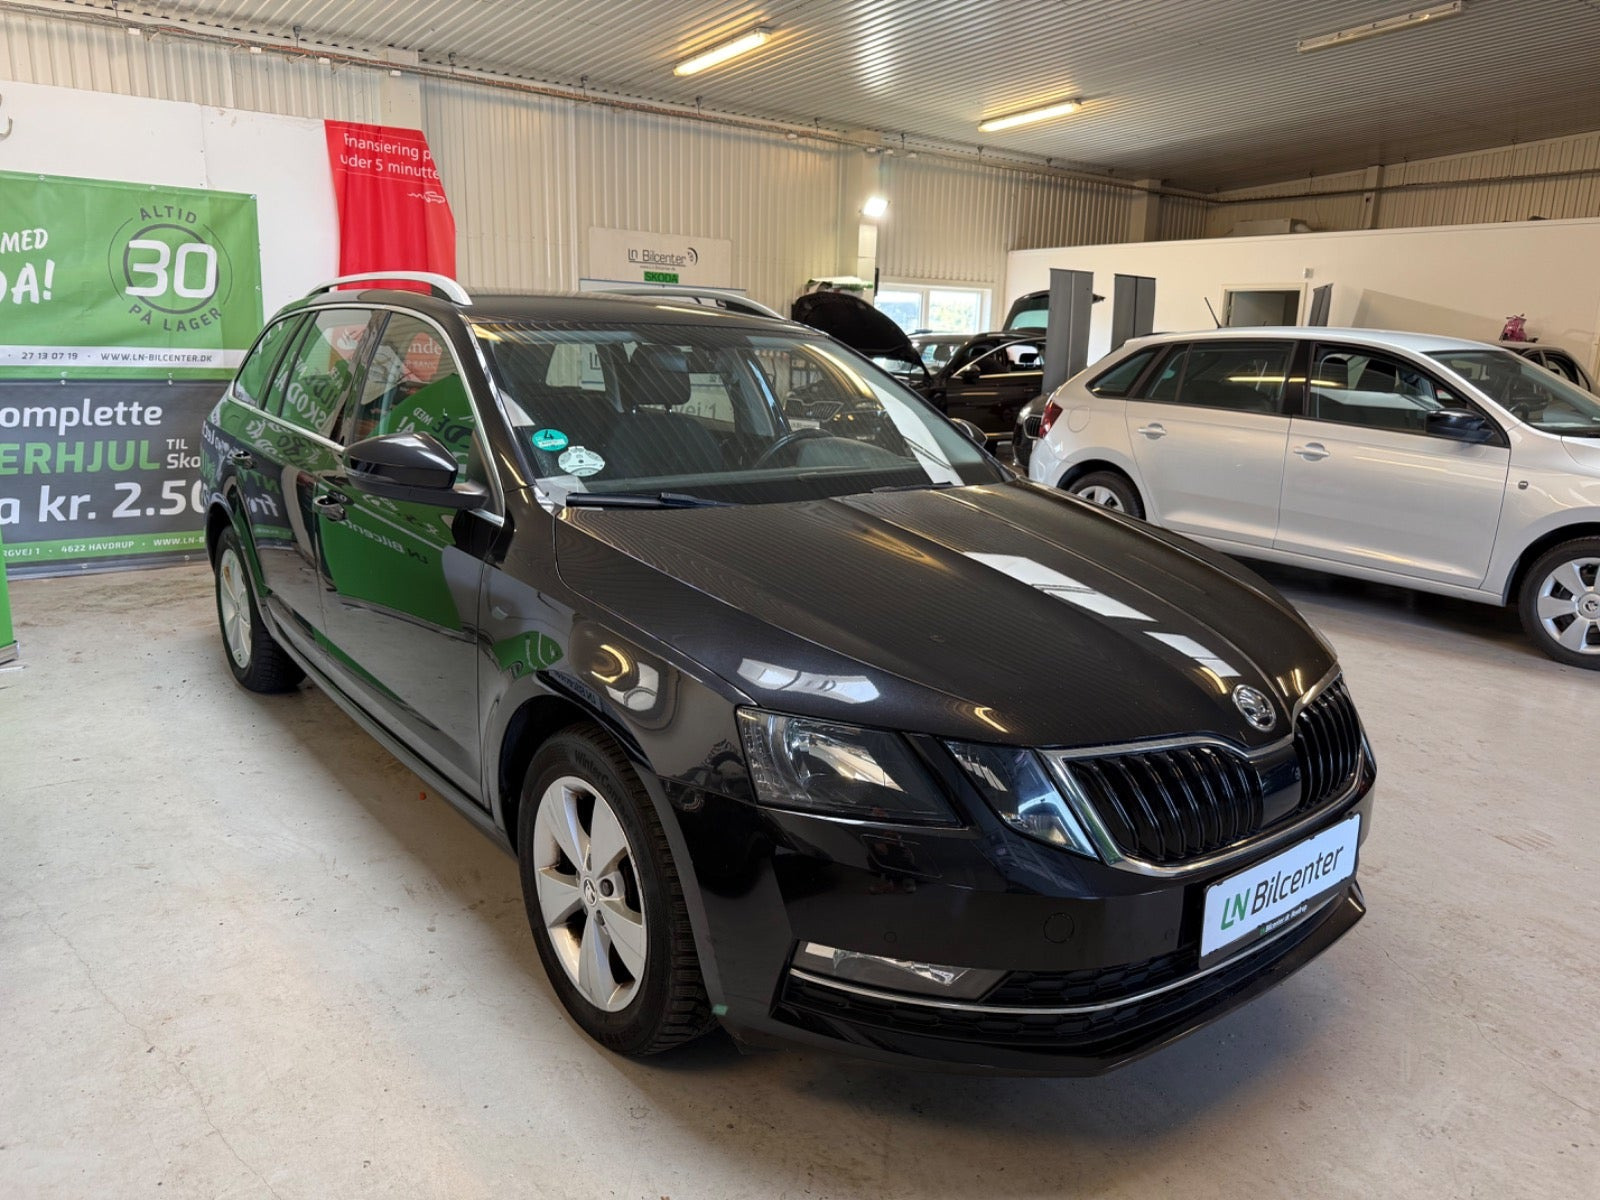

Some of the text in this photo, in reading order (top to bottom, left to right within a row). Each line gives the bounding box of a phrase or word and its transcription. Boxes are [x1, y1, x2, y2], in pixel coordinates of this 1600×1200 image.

[375, 158, 383, 172] 5
[388, 161, 440, 180] minutte
[139, 205, 197, 224] ALTID
[0, 228, 48, 254] MED
[642, 249, 686, 264] Bilcenter
[125, 239, 218, 299] 30
[163, 307, 222, 332] LAGER
[22, 352, 213, 363] 27 13 07 19 WWW.LN-BILCENTER.DK
[166, 438, 188, 450] TIL
[38, 485, 96, 523] kr.
[61, 544, 86, 553] 4622
[88, 540, 134, 551] HAVDRUP
[1219, 886, 1251, 931] LN
[1250, 845, 1345, 916] Bilcenter
